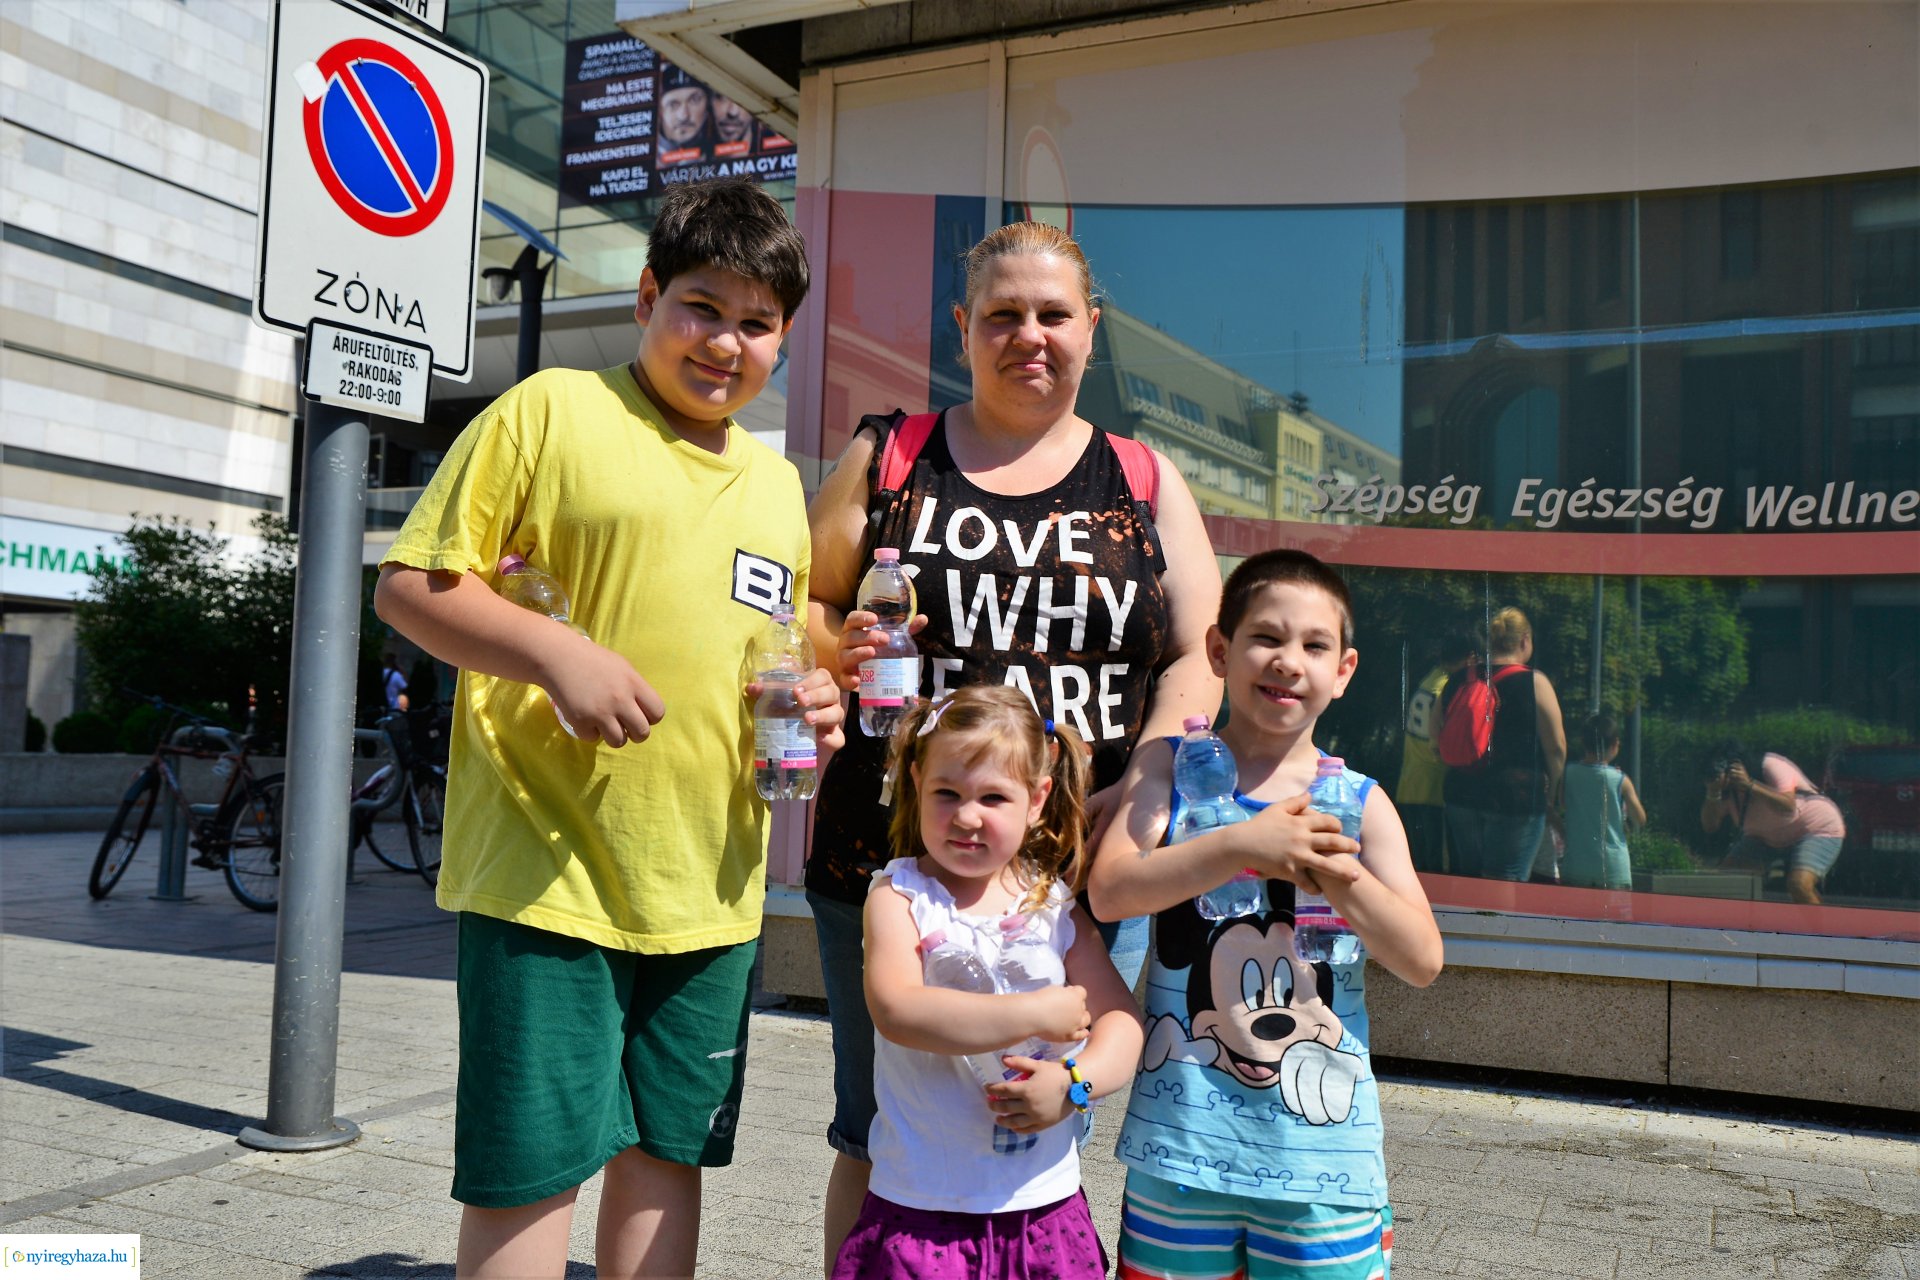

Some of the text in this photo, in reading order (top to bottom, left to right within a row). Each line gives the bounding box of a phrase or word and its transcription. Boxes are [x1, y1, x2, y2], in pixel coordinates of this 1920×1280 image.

[585, 38, 647, 60] SPAMALO
[606, 76, 654, 96] MA ESTE
[598, 110, 652, 129] TELJESEN
[594, 123, 651, 143] IDEGENEK
[566, 142, 650, 166] FRANKENSTEIN
[718, 162, 731, 177] A
[732, 155, 778, 175] NAGY
[601, 167, 630, 182] KAPJ
[589, 183, 607, 197] HA
[314, 268, 426, 334] ZÓNA
[332, 332, 419, 371] ÁRUFELTÖLTÉS,
[348, 360, 402, 386] RAKODÁS
[339, 379, 401, 406] 22:00-9:00
[1307, 474, 1920, 529] Szépség Egészség Wellne
[908, 496, 1094, 568] LOVE
[945, 568, 1138, 653] WHY
